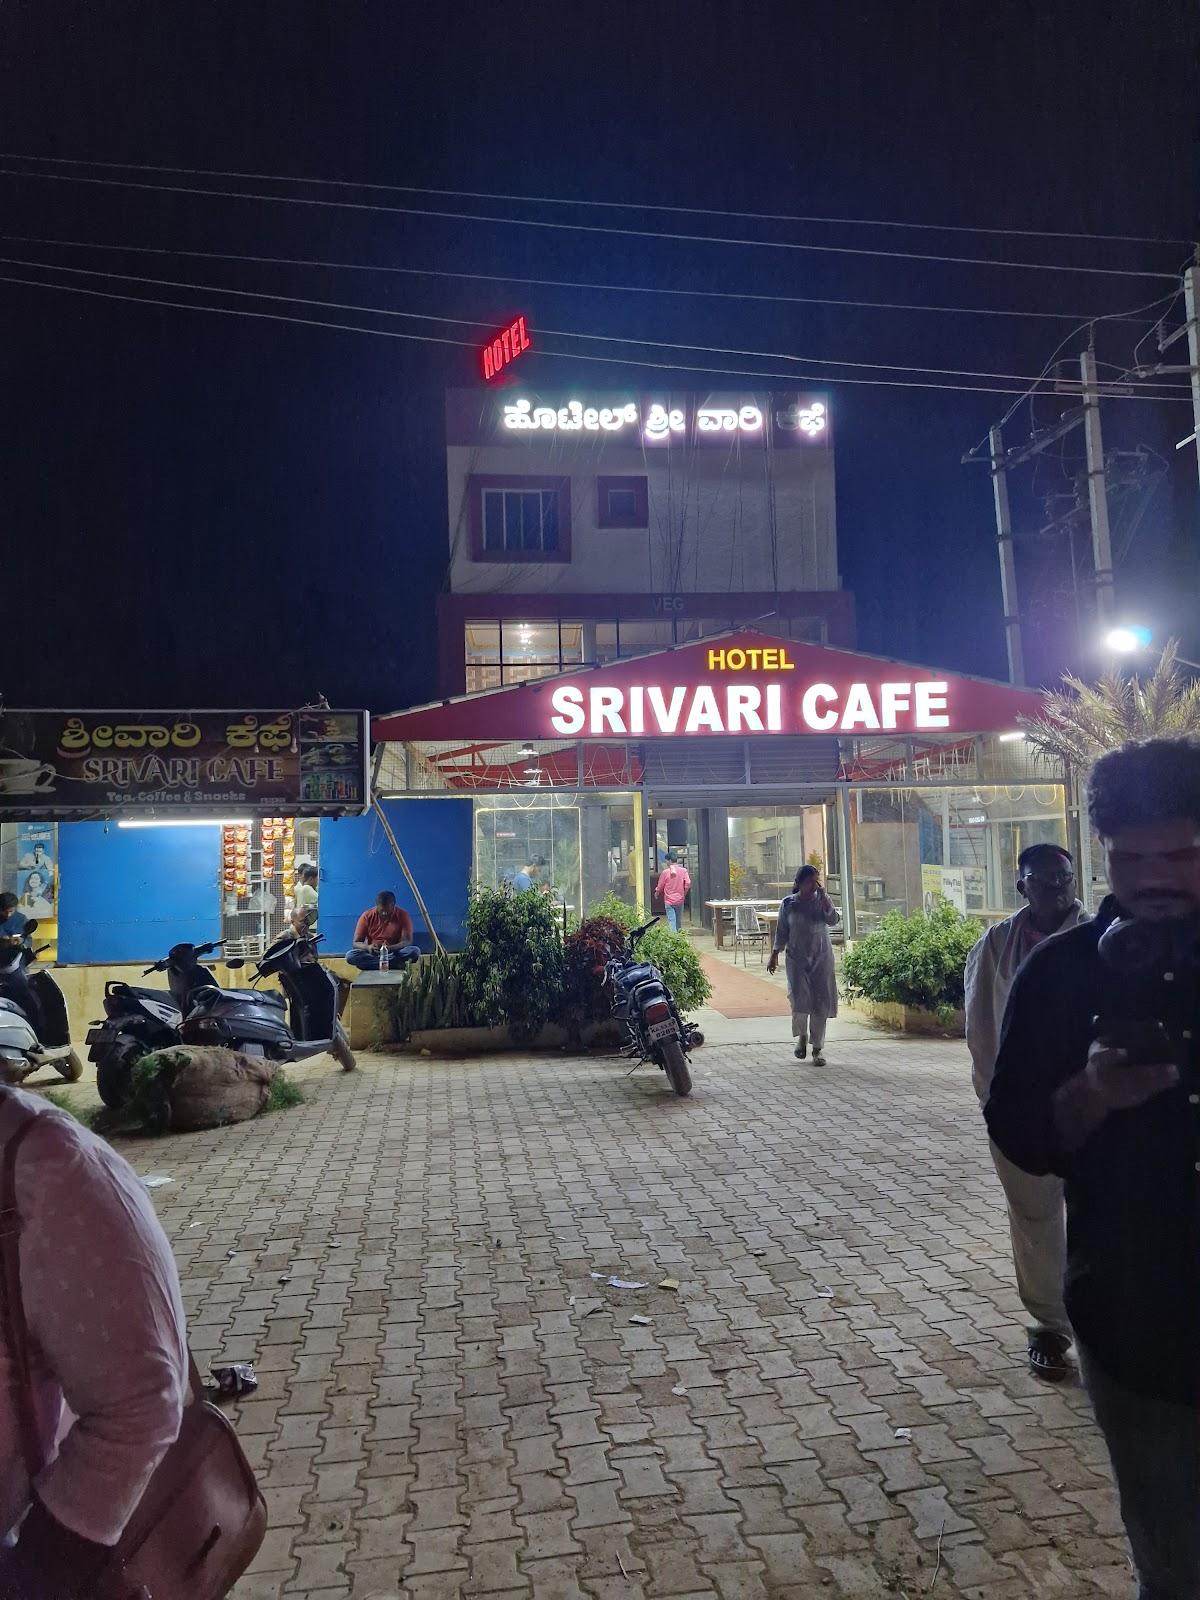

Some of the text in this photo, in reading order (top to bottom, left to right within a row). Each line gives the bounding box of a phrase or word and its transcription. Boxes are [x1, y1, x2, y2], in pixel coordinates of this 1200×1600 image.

[484, 316, 530, 379] HOTEL
[645, 404, 686, 440] ಶ್ರೀ
[697, 406, 763, 431] ವಾರಿ
[708, 648, 795, 671] HOTEL
[551, 681, 950, 735] SRIVARI CAFE
[83, 754, 284, 788] SRIVARI CAFE
[138, 791, 181, 802] Coffee
[184, 791, 191, 803] &
[194, 791, 246, 801] Snacks
